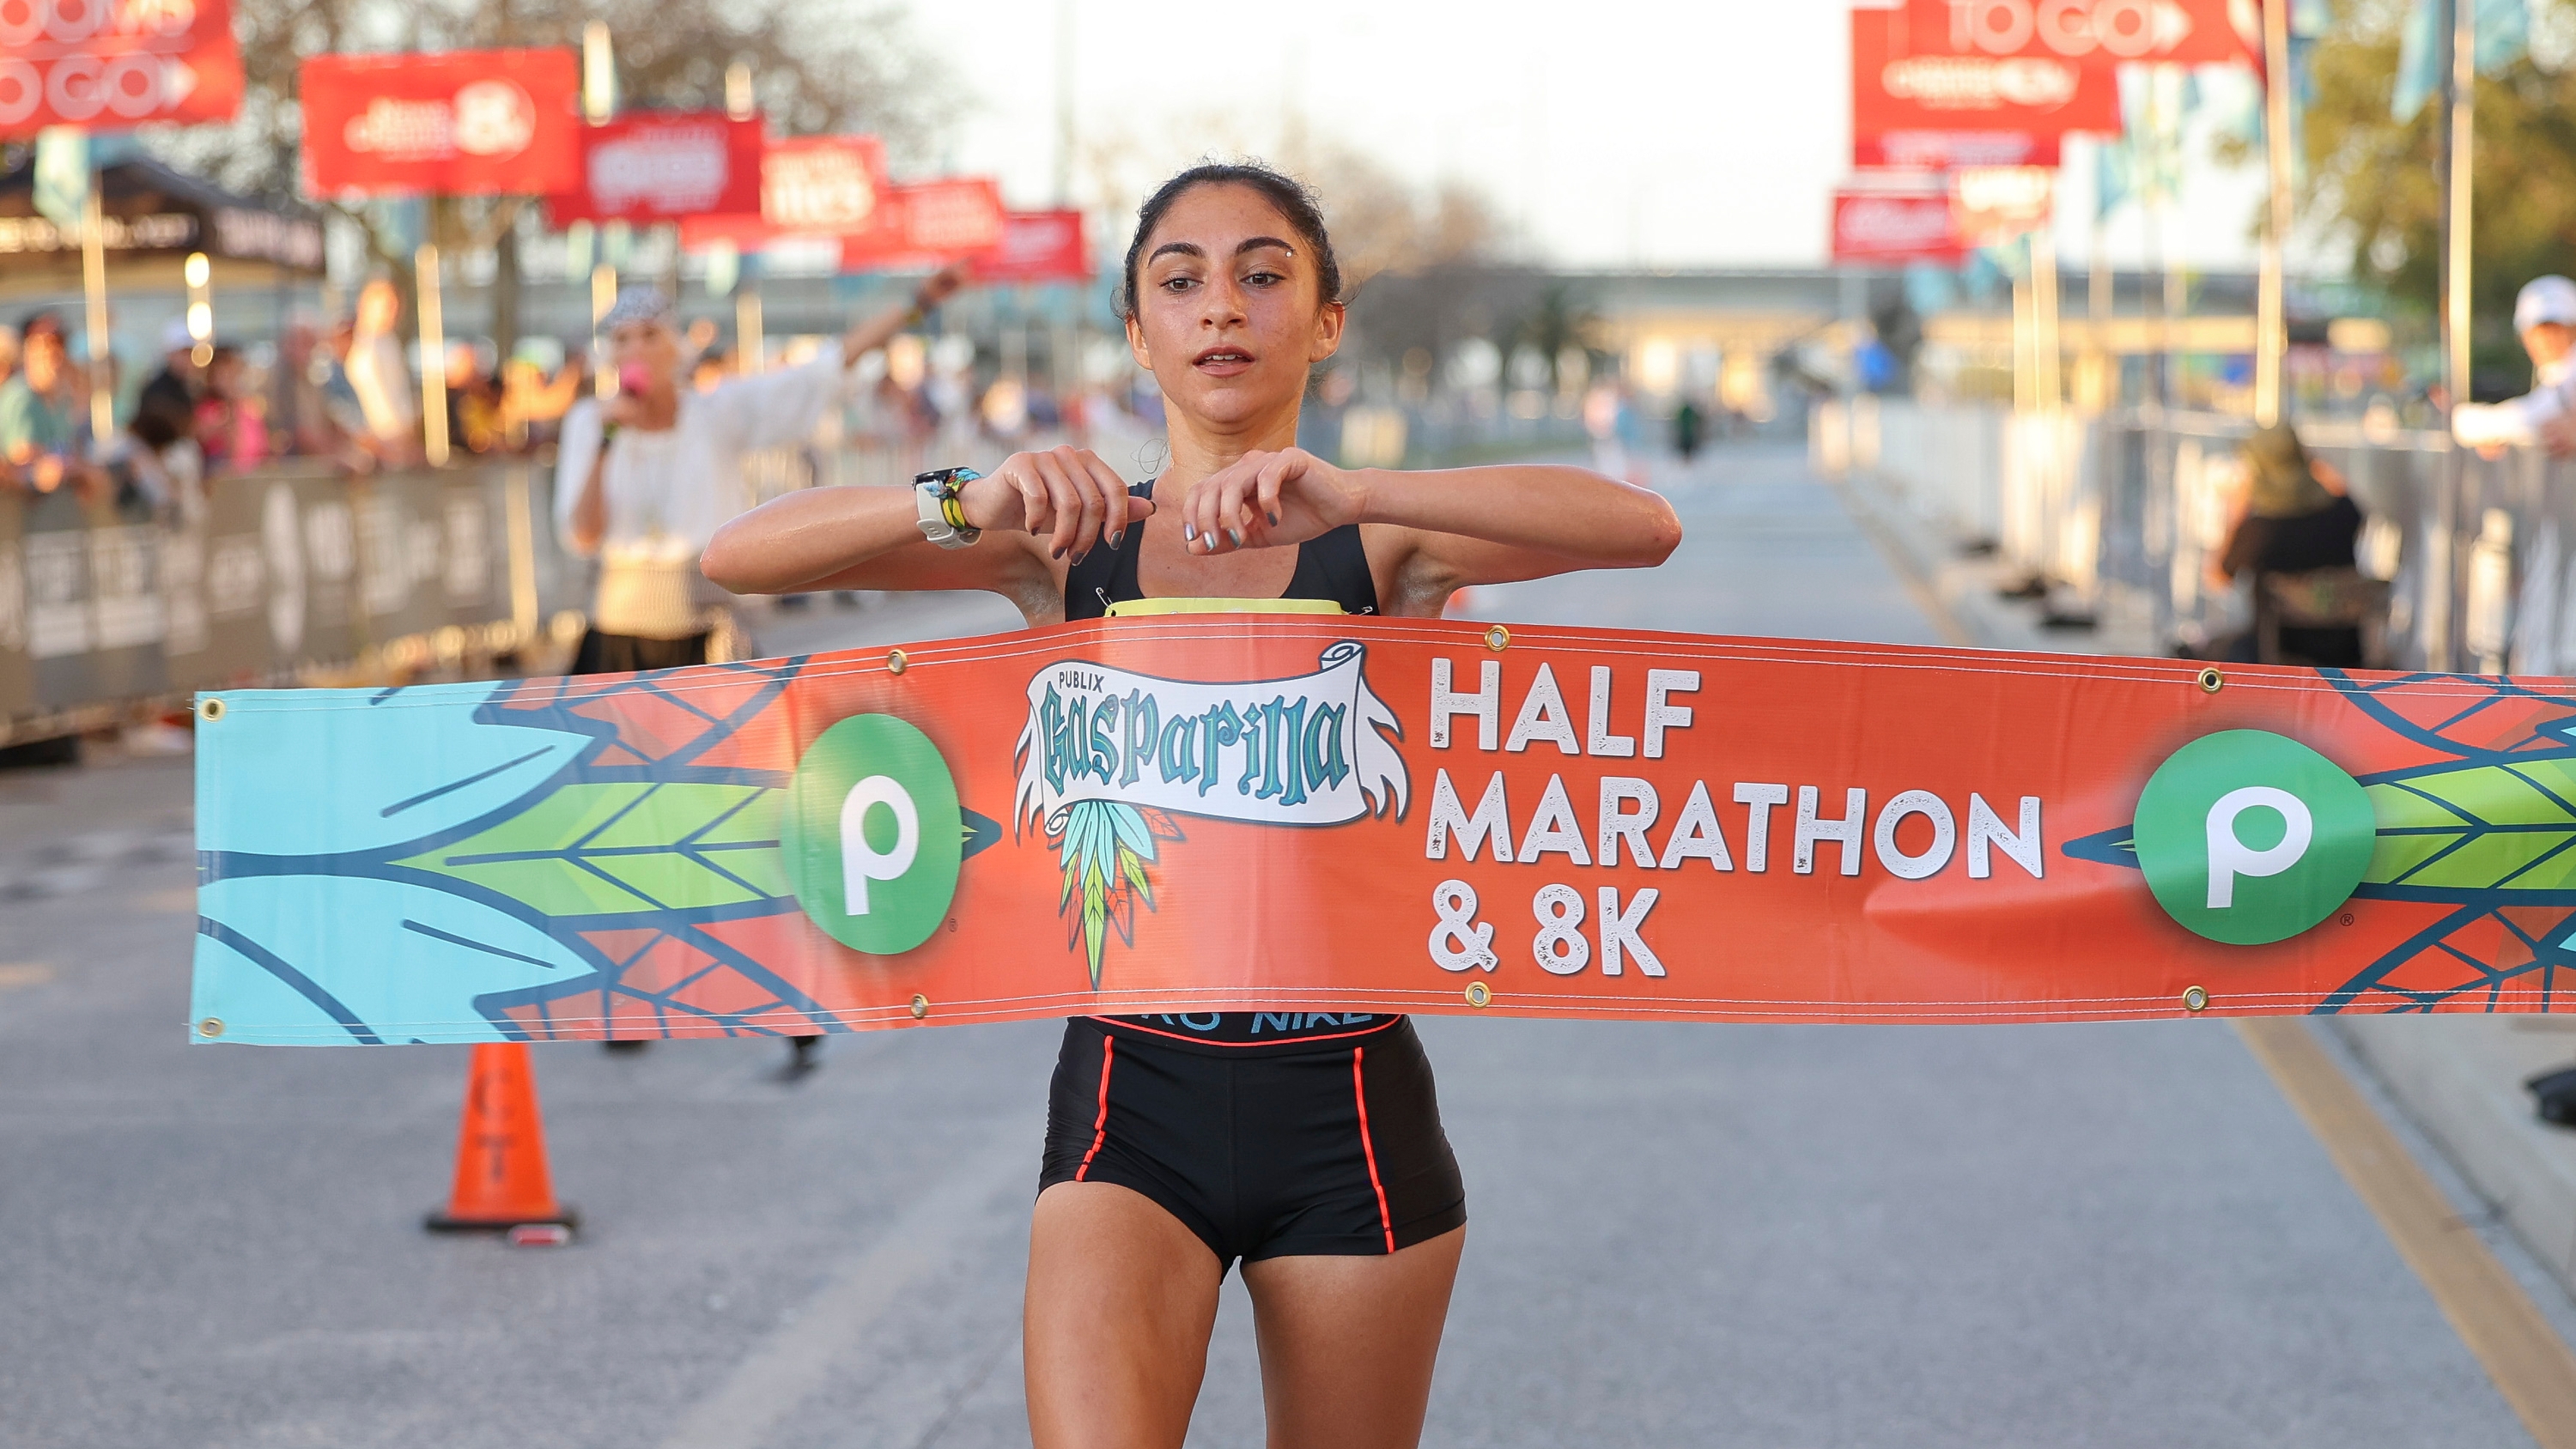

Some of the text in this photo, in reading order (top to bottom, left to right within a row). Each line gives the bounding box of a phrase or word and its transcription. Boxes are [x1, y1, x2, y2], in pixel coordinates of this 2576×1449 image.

[1059, 671, 1104, 693] PUBLIX
[1430, 658, 1701, 758] HALF
[1425, 768, 2043, 879] MARATHON
[1428, 879, 1667, 977] & 8K
